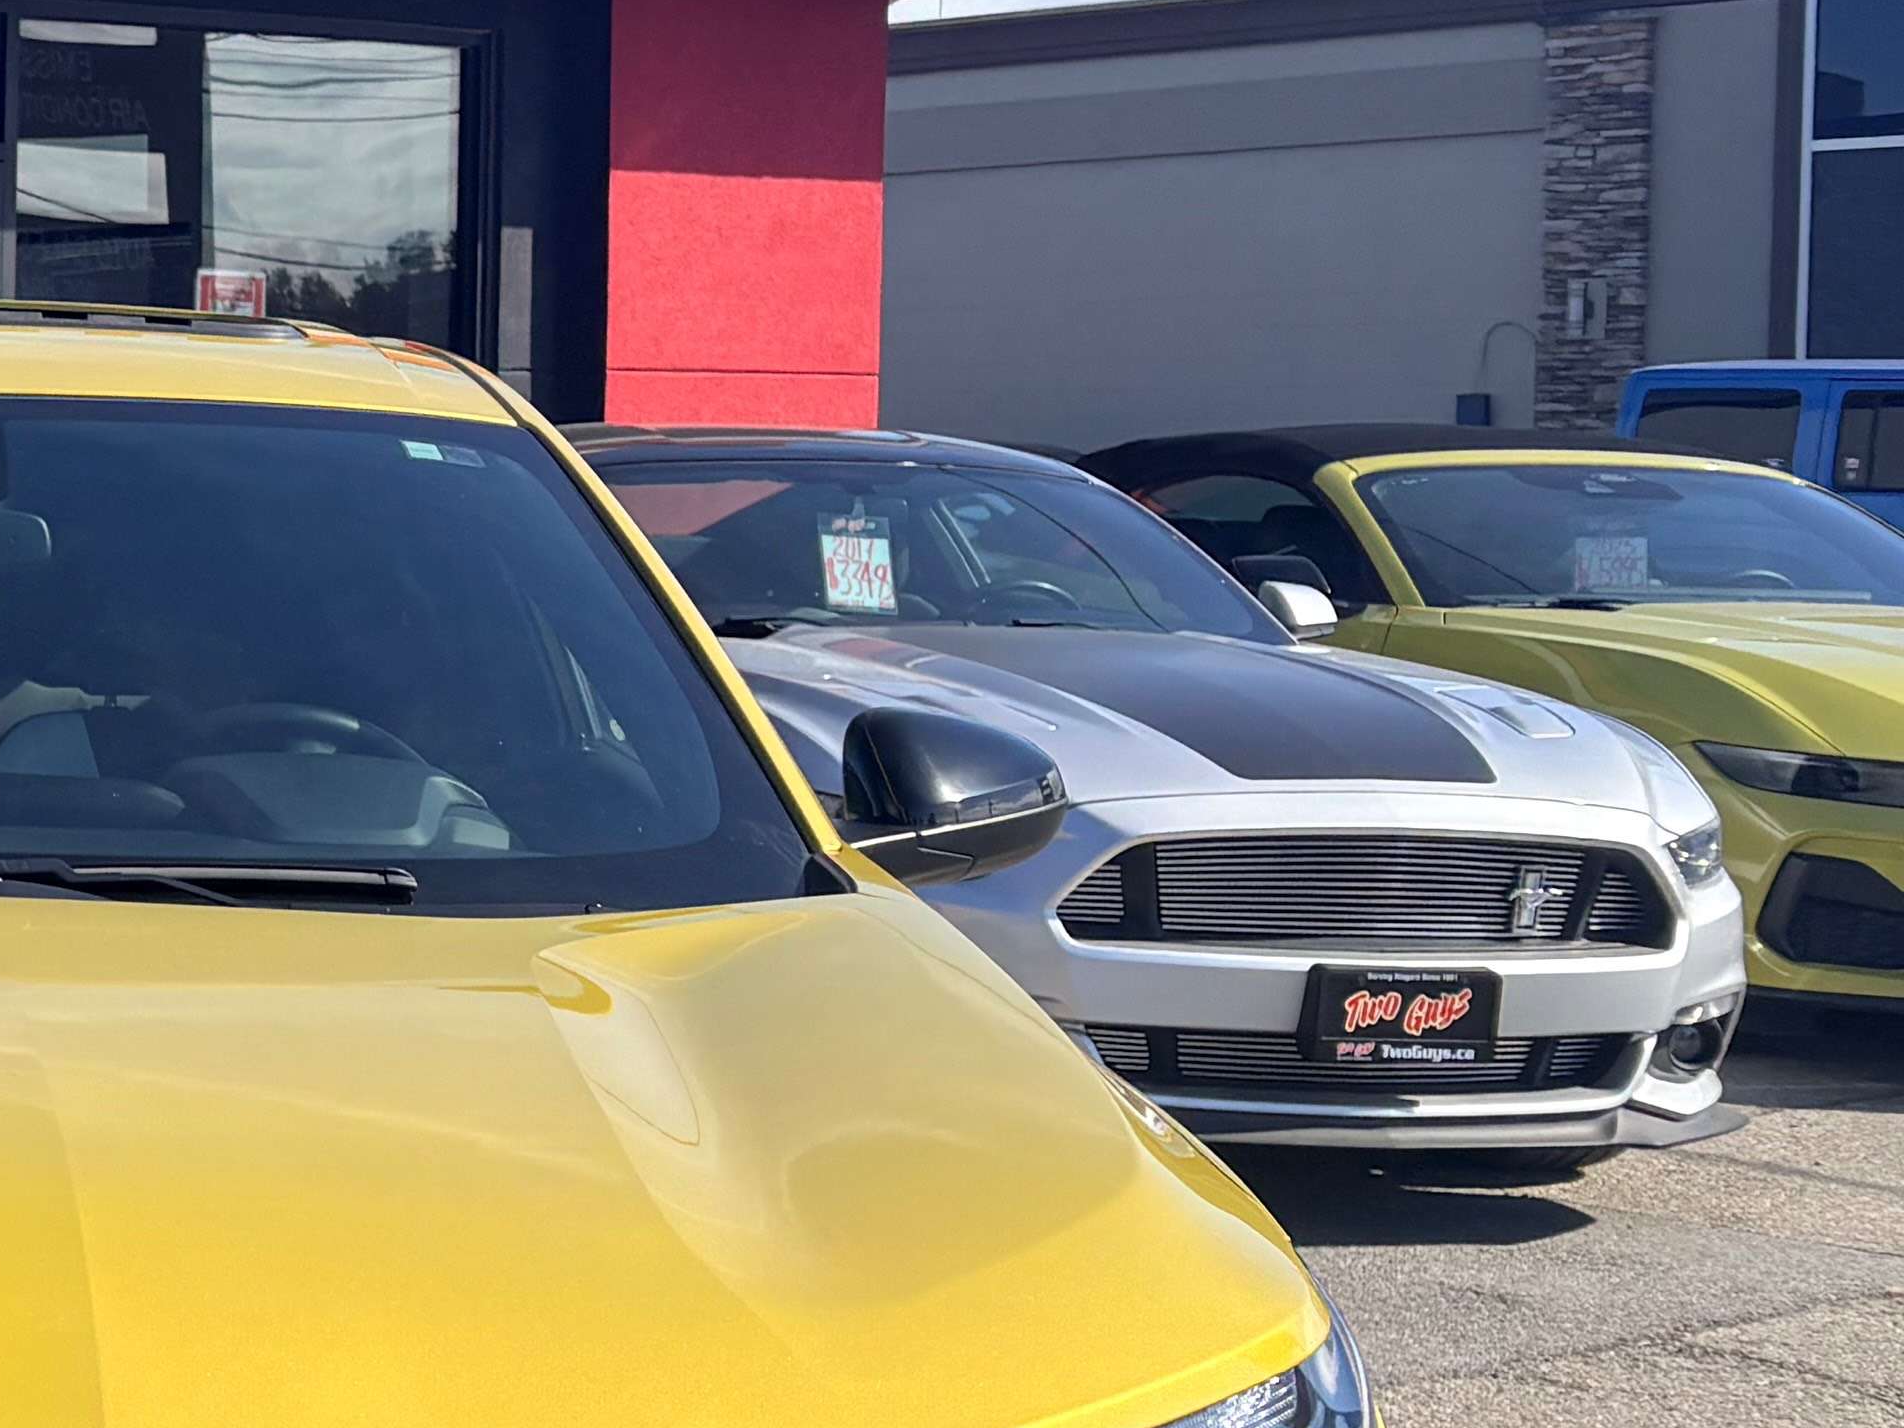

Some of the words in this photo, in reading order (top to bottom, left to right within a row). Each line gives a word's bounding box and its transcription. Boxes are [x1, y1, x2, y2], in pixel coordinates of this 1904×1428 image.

[1345, 990, 1402, 1032] Two
[1403, 988, 1472, 1036] Guys
[1380, 1044, 1475, 1062] TwoGuys.ca
